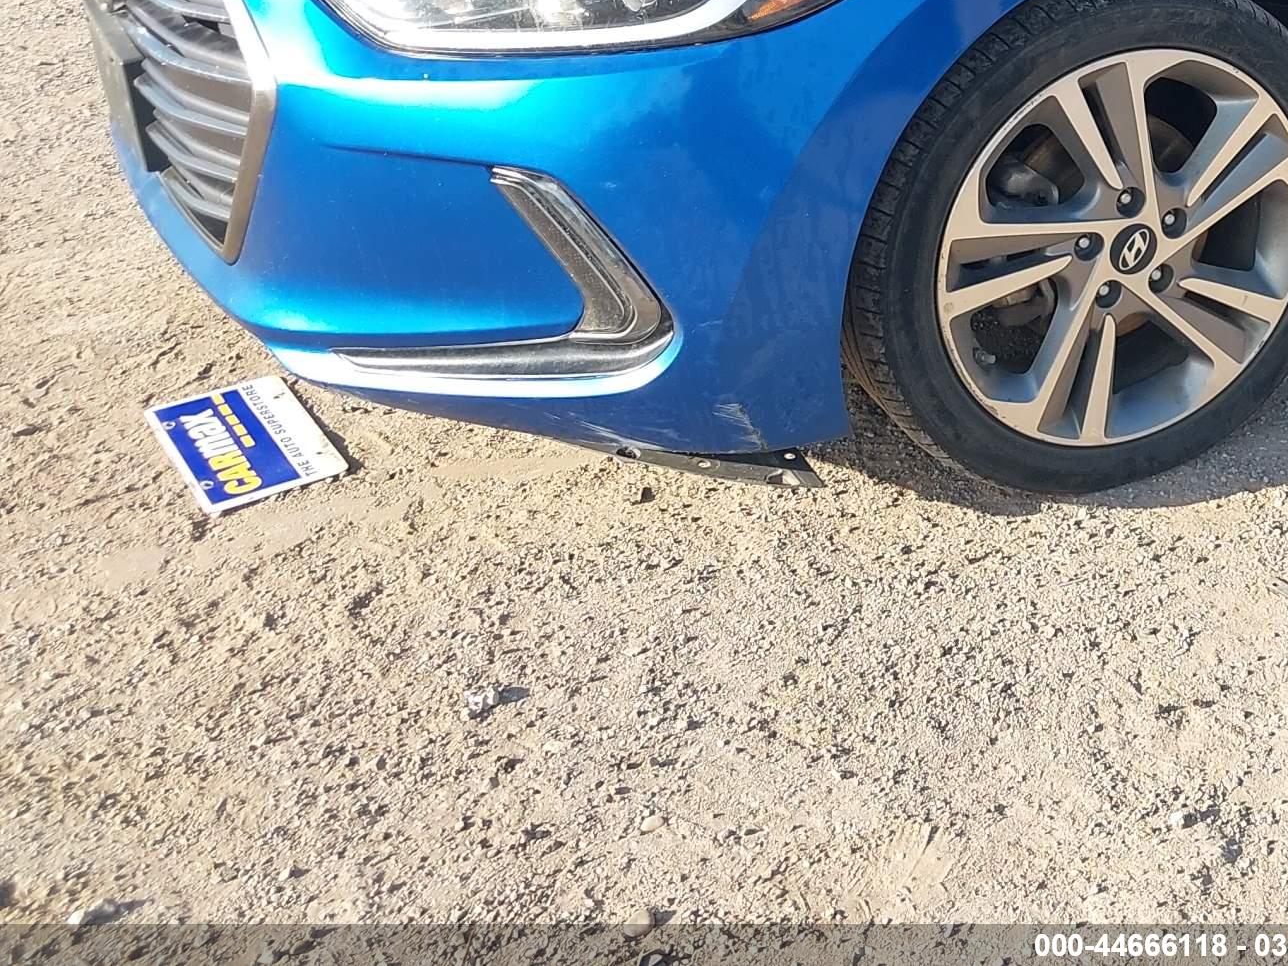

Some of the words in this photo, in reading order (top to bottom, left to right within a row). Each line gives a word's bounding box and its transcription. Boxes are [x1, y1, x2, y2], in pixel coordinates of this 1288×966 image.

[241, 384, 286, 435] SUPERSTORE
[280, 436, 302, 458] AUTO
[297, 460, 320, 477] THE
